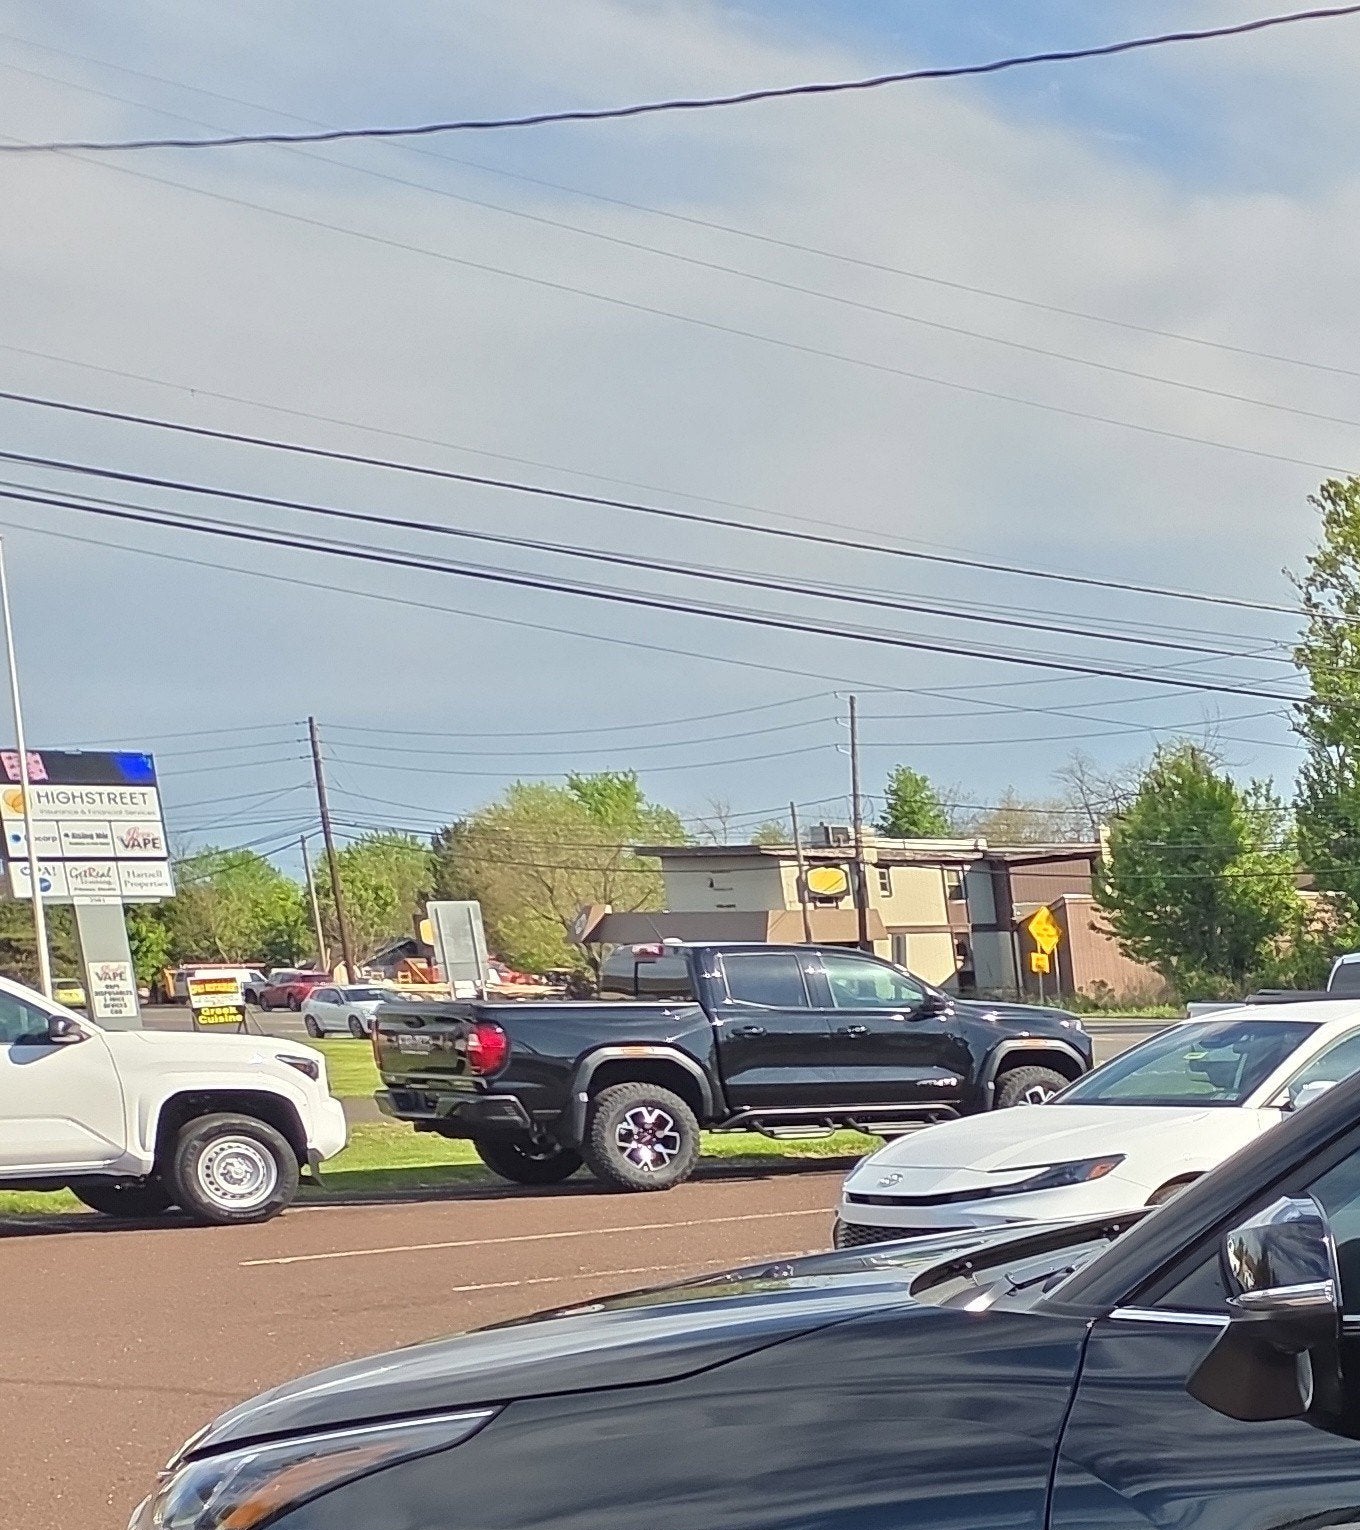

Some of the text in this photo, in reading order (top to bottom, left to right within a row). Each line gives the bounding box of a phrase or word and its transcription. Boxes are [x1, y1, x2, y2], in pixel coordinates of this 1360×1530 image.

[36, 790, 148, 806] HIGHSTREET
[119, 837, 161, 850] VAPE
[20, 866, 57, 877] OA!
[94, 971, 127, 982] VAPE
[201, 1005, 238, 1016] Greek
[198, 1013, 243, 1025] Cuisine
